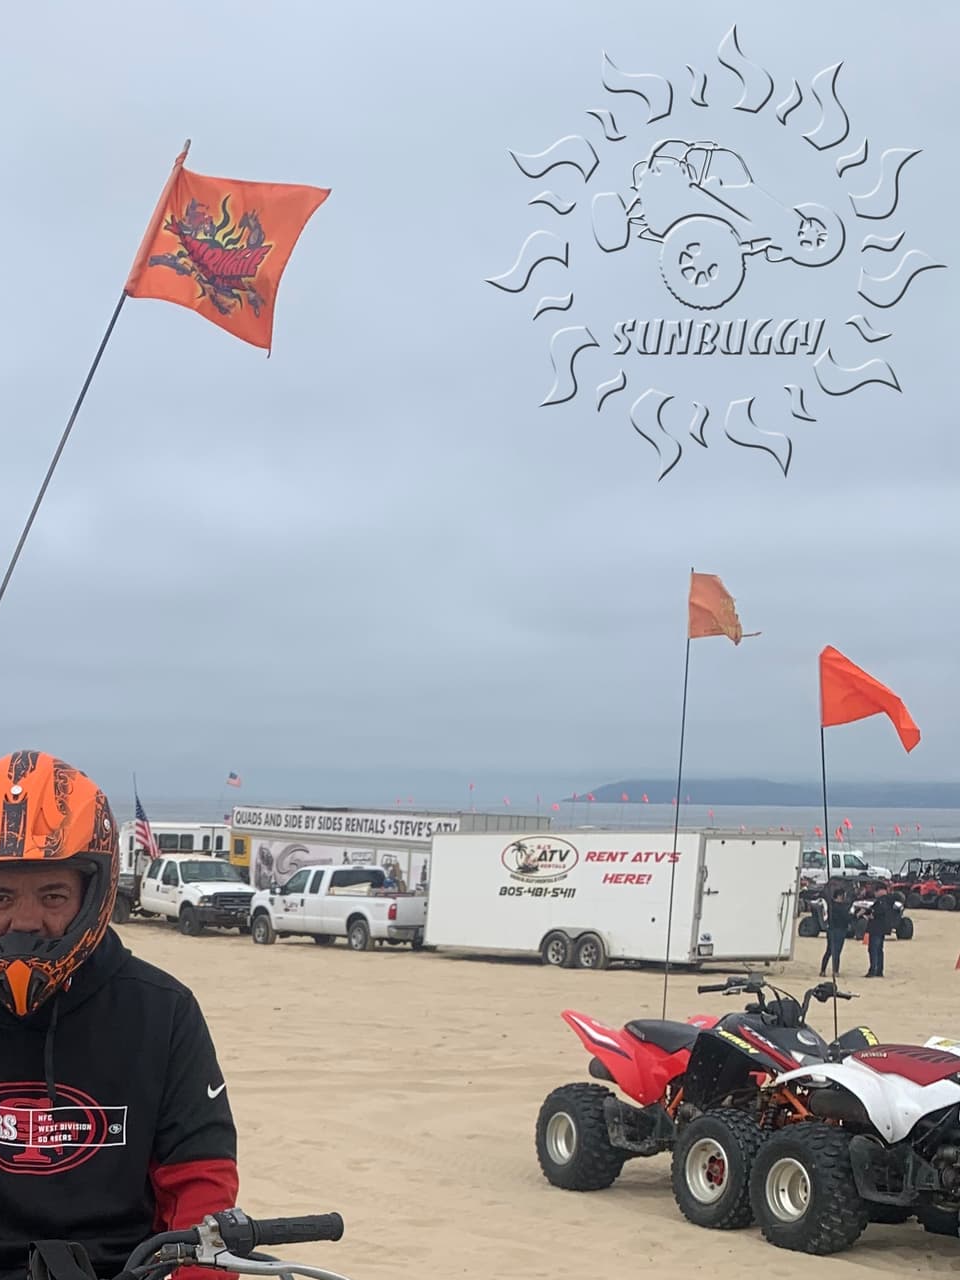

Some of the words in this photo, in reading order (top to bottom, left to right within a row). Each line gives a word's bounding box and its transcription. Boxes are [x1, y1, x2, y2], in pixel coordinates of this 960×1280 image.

[235, 810, 262, 826] QUADS
[264, 813, 282, 828] AND
[284, 814, 302, 829] SIDE
[304, 815, 316, 830] BY
[317, 815, 343, 832] SIDES
[345, 817, 386, 835] RENTALS
[393, 819, 432, 838] STEVE'S
[537, 850, 570, 862] ATV
[585, 852, 629, 863] RENT
[631, 852, 681, 863] ATV'S
[602, 873, 652, 885] HERE!
[499, 886, 576, 898] 805-481-5411
[59, 1123, 92, 1131] DIVISION
